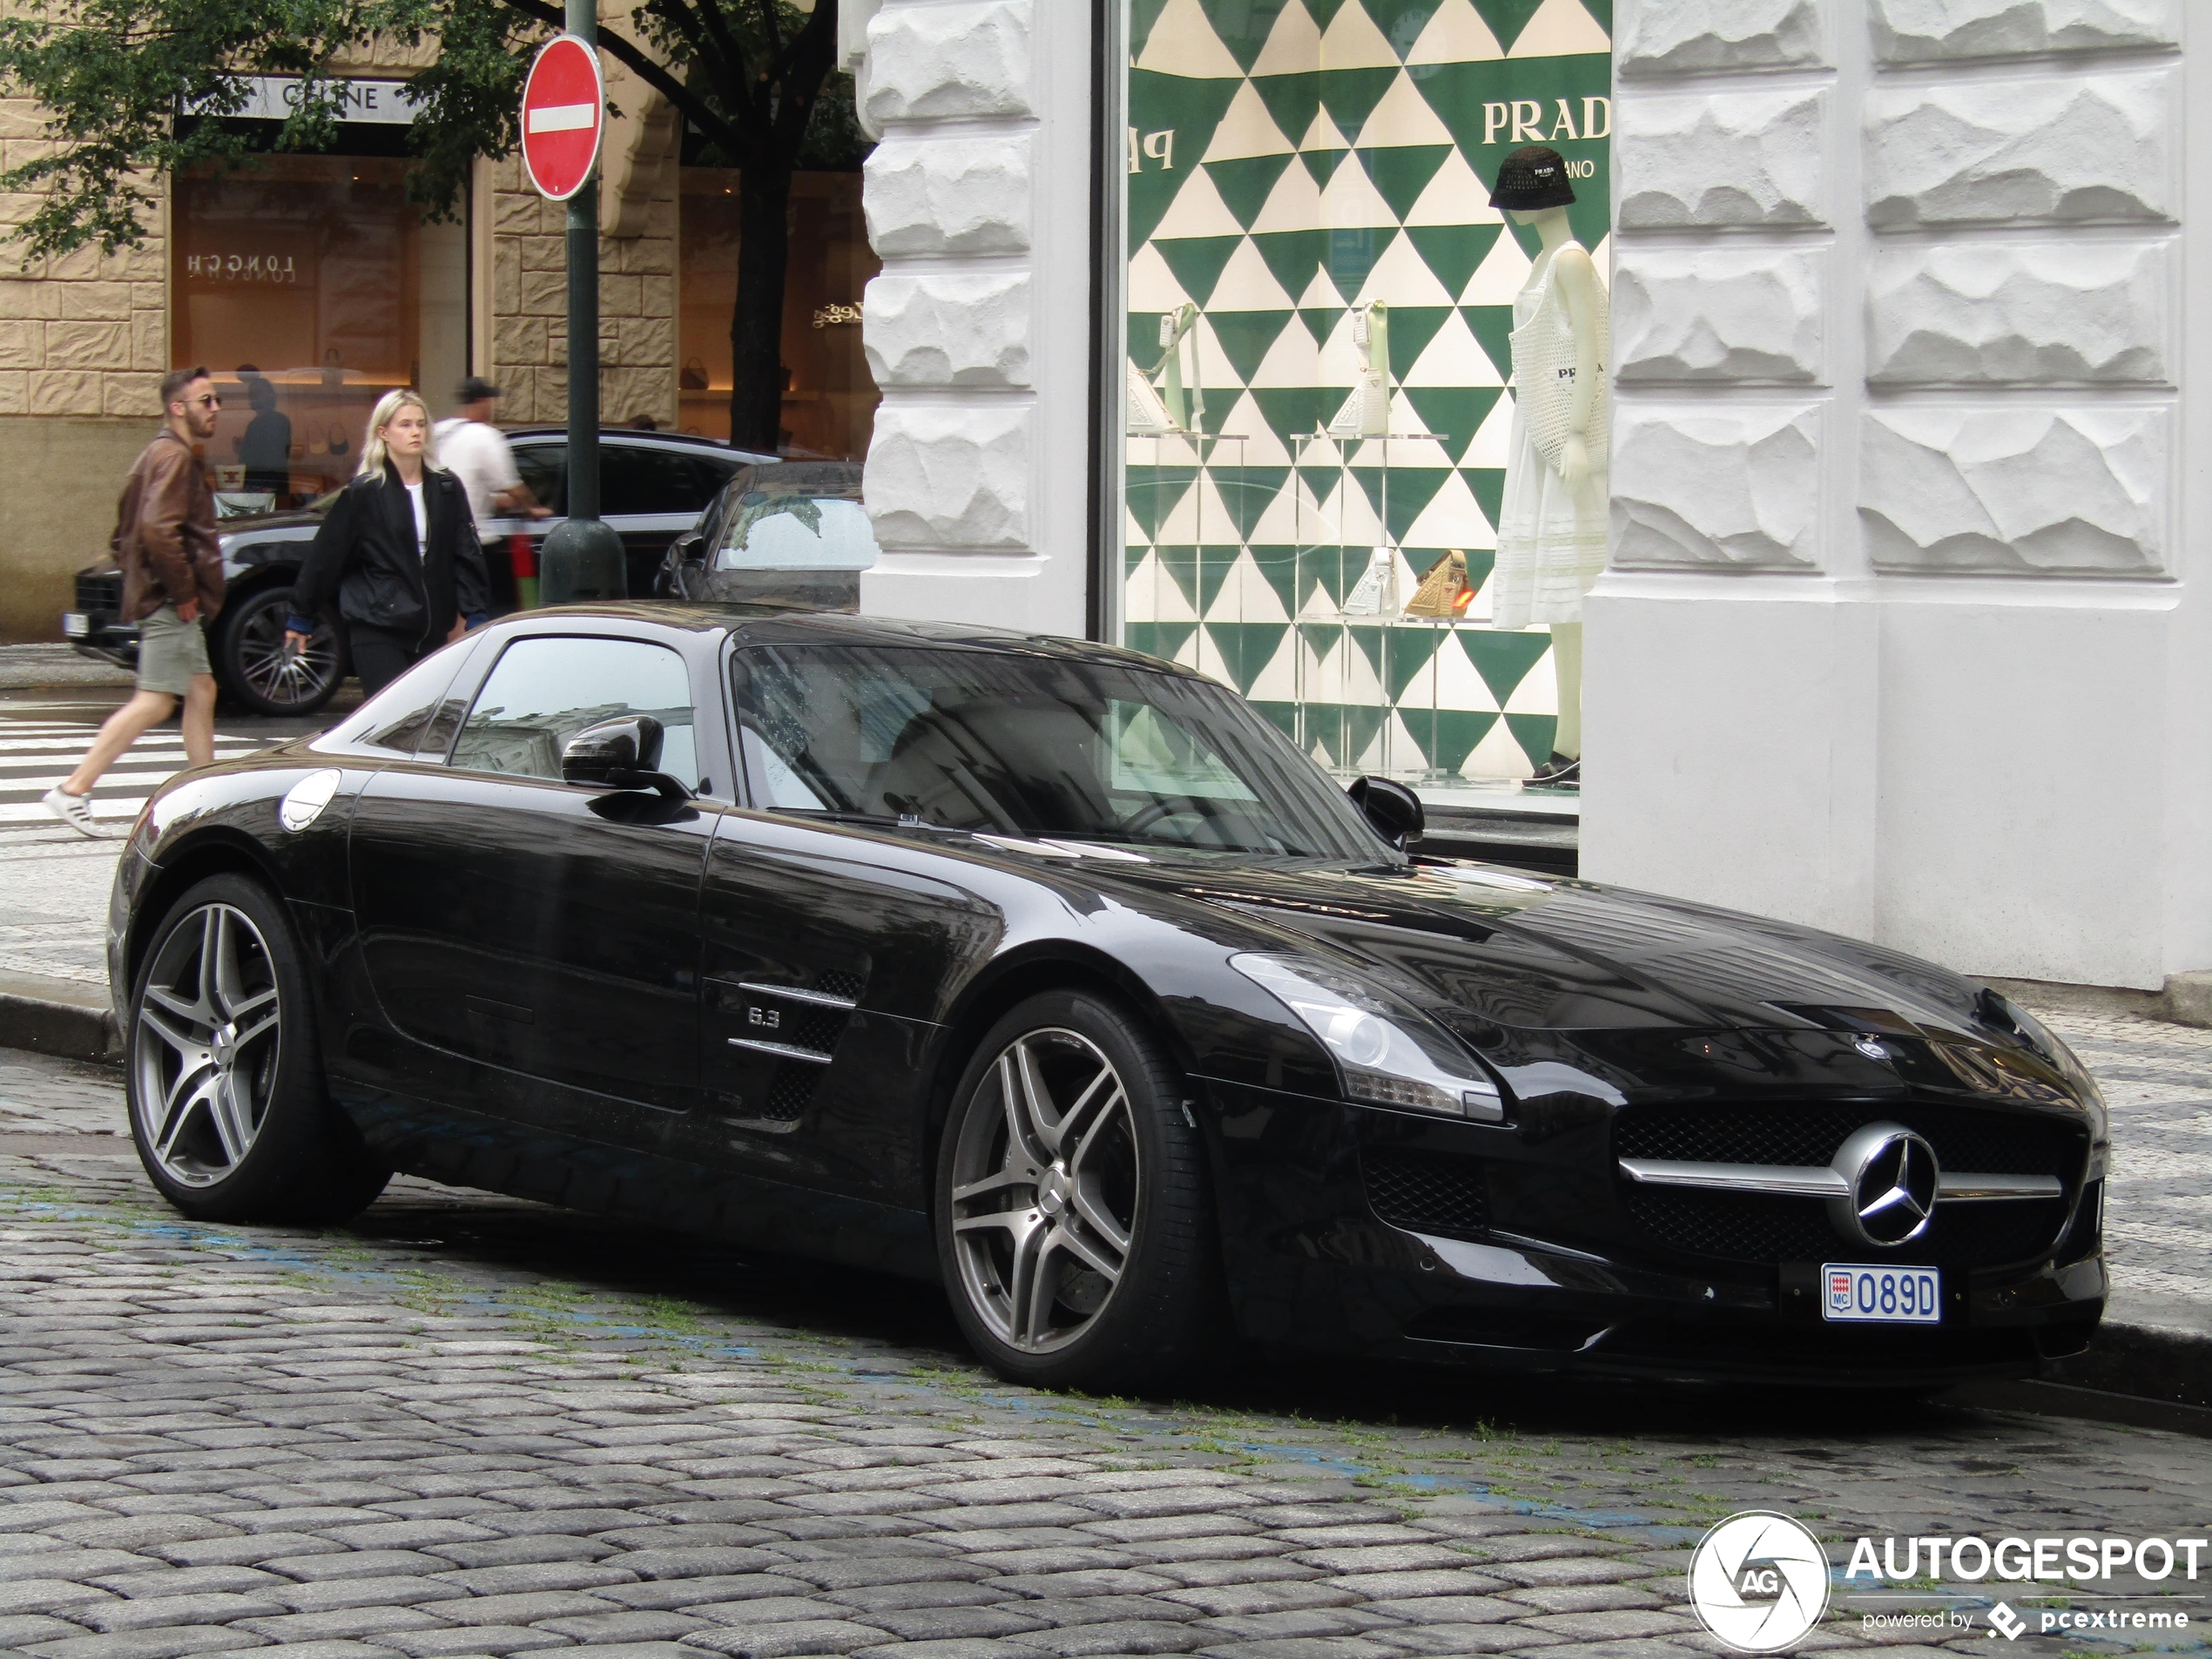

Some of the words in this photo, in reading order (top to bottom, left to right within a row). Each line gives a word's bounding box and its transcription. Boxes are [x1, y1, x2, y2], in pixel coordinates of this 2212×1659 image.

[1481, 97, 1611, 145] PRAD
[749, 1007, 780, 1028] 6.3
[1833, 1293, 1848, 1305] MC
